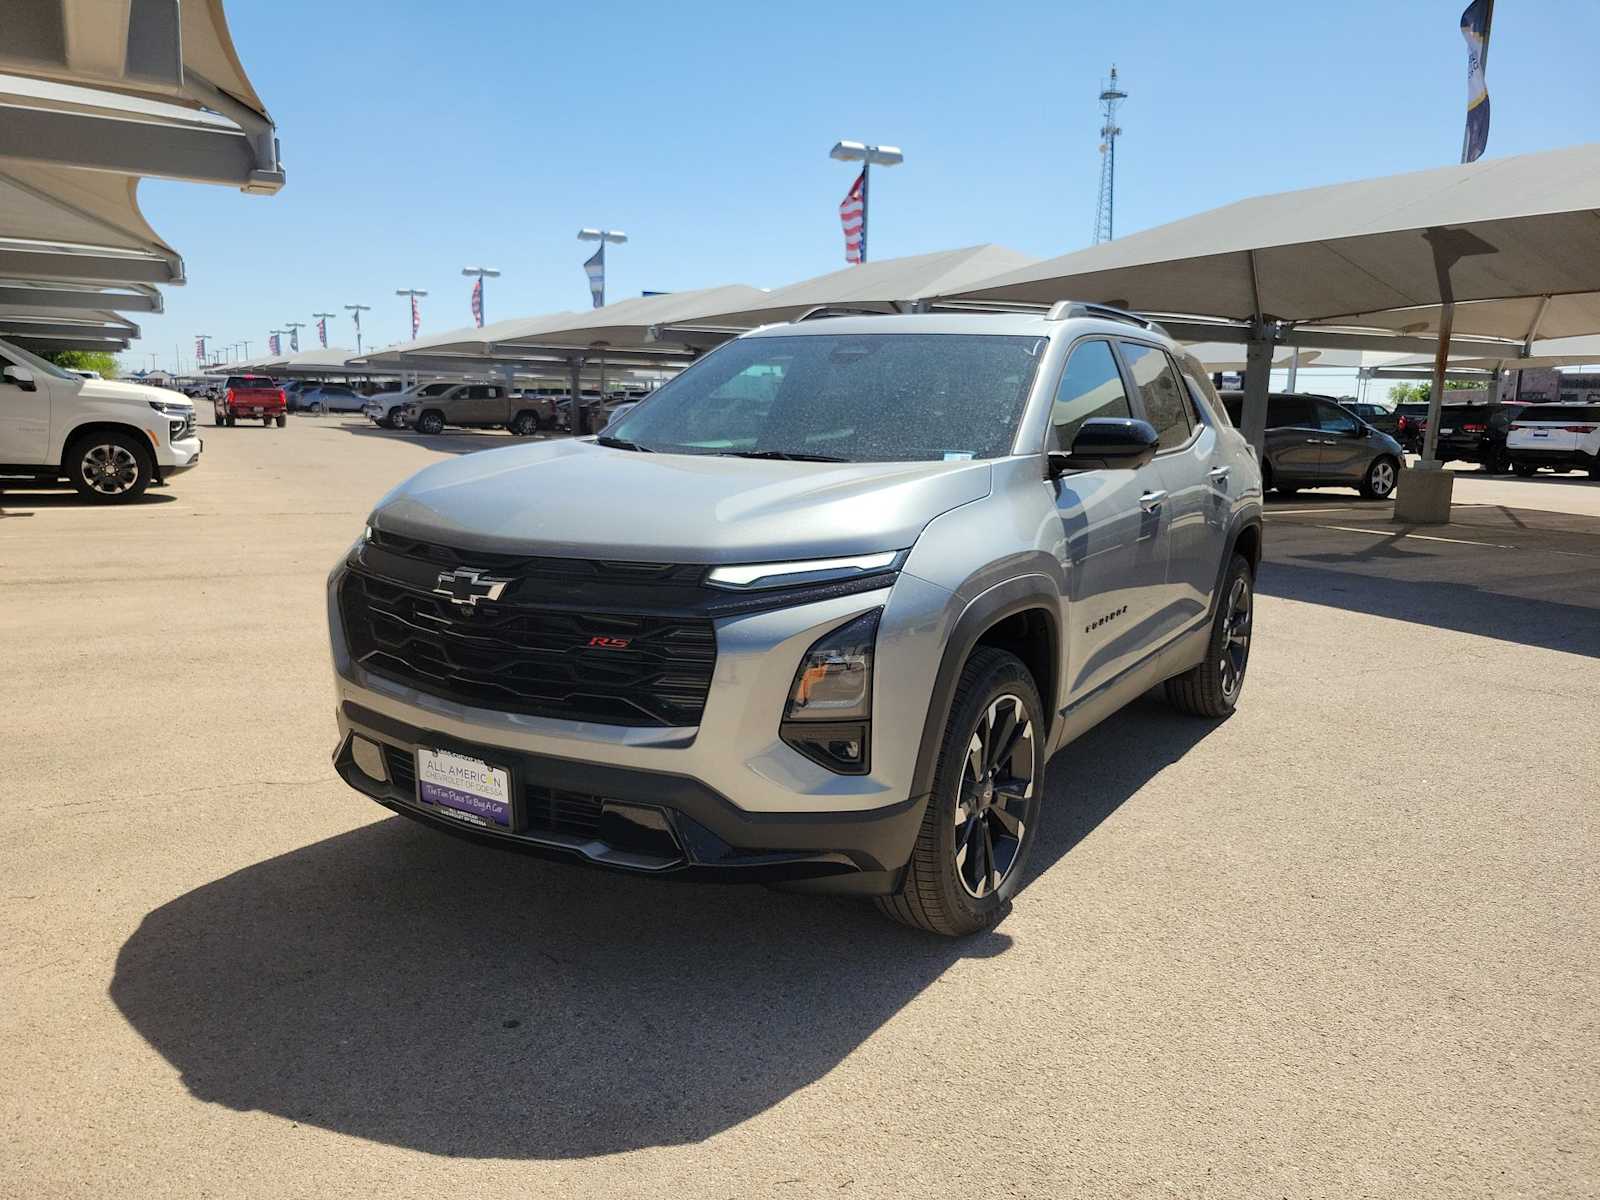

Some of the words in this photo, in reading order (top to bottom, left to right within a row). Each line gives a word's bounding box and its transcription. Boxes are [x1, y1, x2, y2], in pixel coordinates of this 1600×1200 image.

[589, 636, 630, 648] RS
[427, 760, 446, 773] ALL
[425, 771, 464, 786] CHEVROLET
[465, 780, 475, 789] OF
[476, 783, 503, 796] ODESSA
[473, 799, 486, 812] Buy
[486, 801, 493, 811] A
